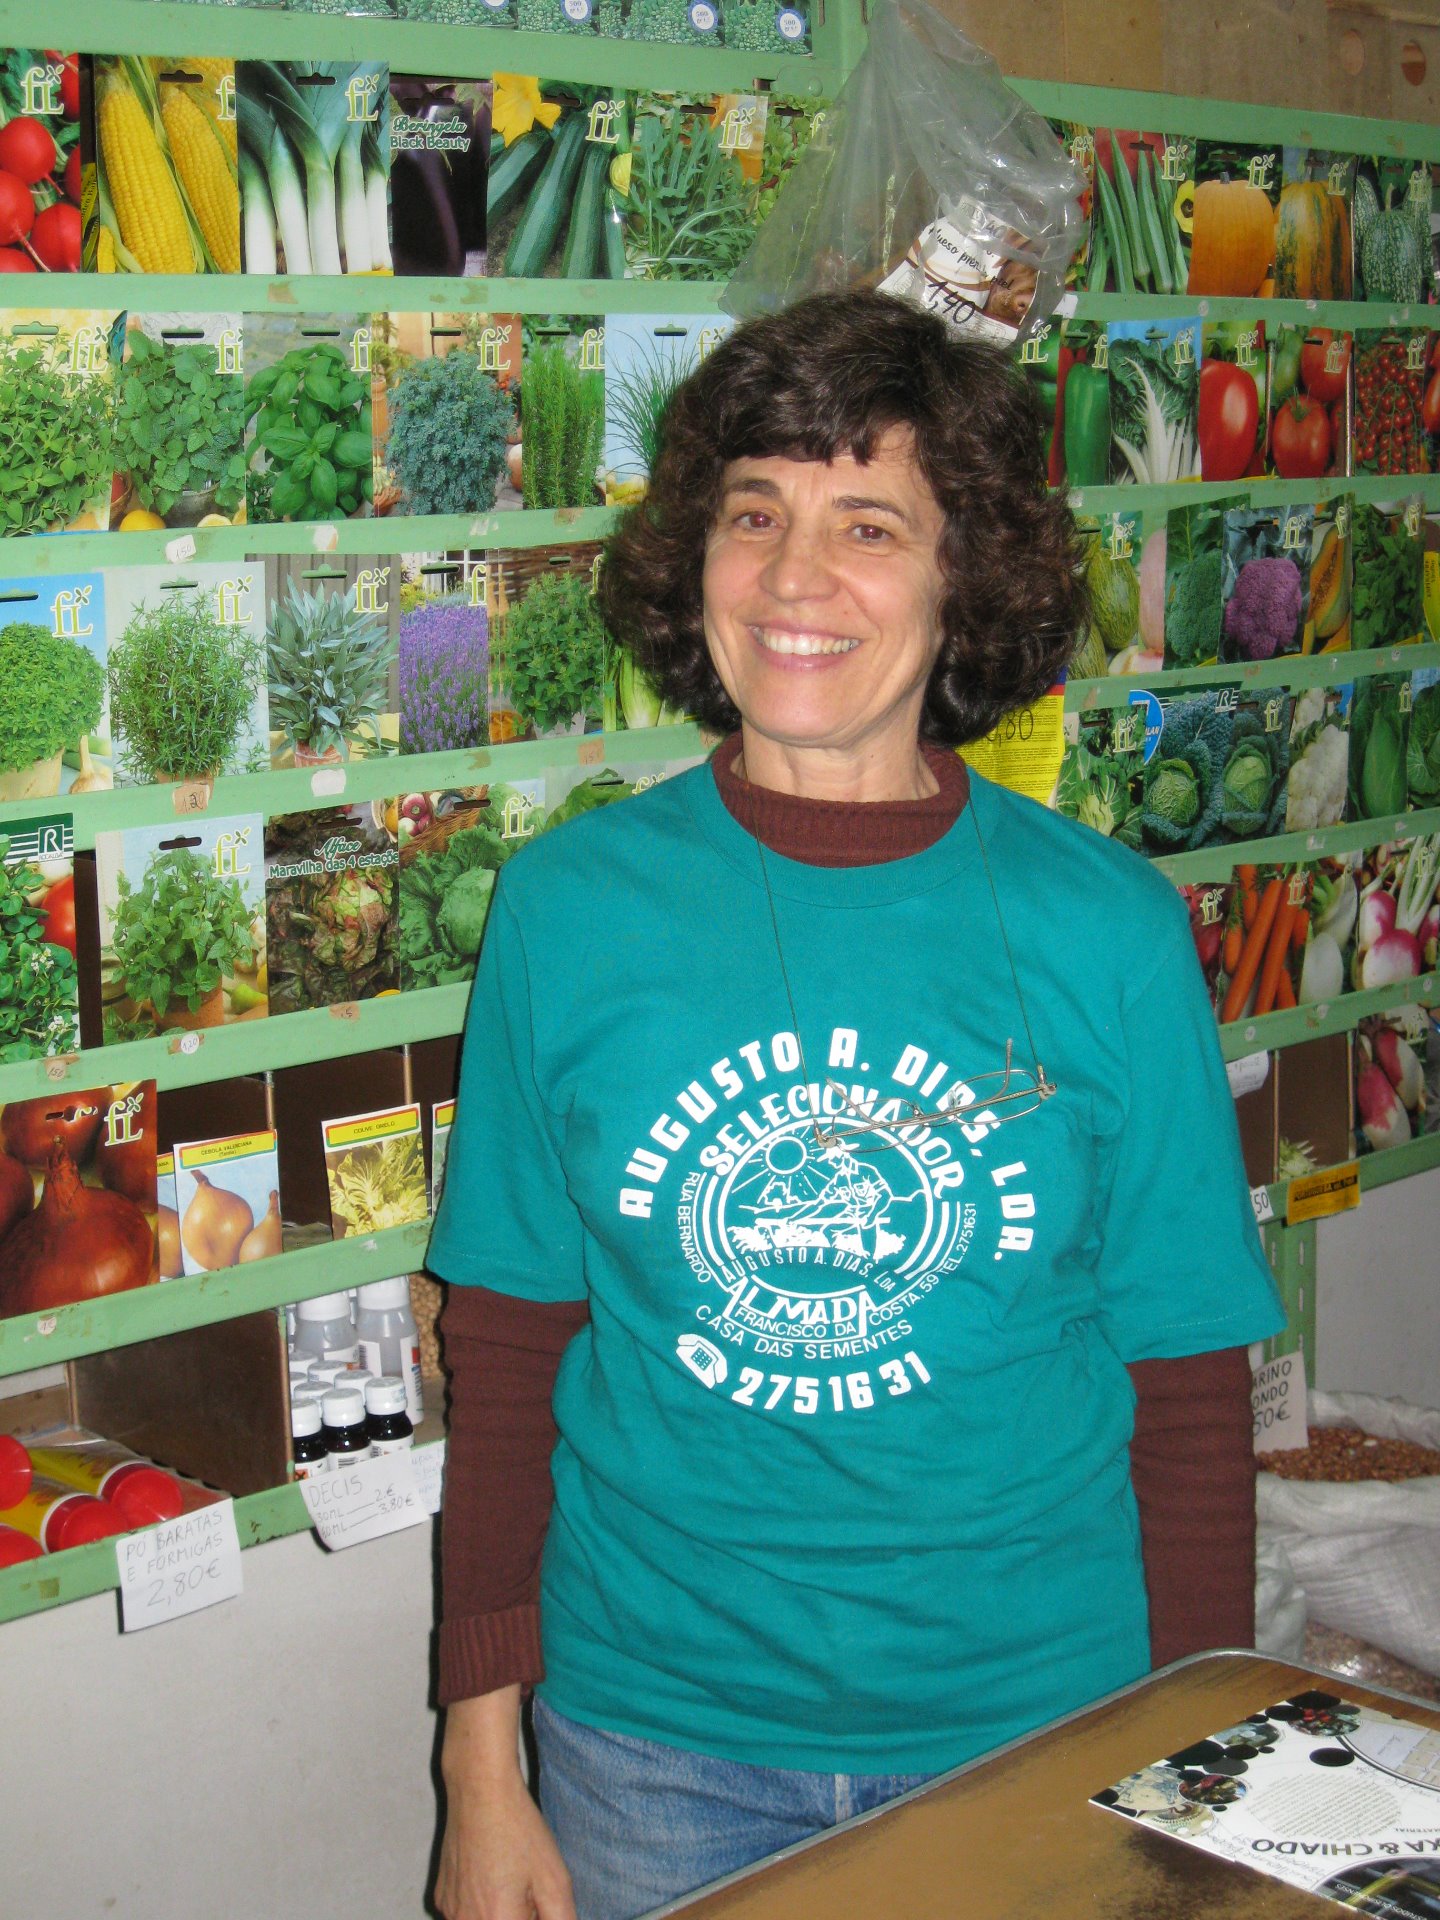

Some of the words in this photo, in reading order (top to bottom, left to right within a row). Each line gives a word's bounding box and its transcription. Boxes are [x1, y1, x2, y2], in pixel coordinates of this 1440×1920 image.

[393, 115, 467, 137] Beringela
[390, 135, 424, 149] Black
[426, 135, 470, 152] Beauty
[927, 281, 976, 324] 1,40
[269, 860, 323, 878] Maravilha
[325, 858, 346, 872] das
[347, 855, 356, 868] 4
[358, 849, 399, 867] estaçõe
[314, 836, 361, 859] Alface
[619, 1031, 799, 1218] AUGUSTO
[829, 1027, 870, 1071] A.
[991, 1161, 1036, 1261] LDA.
[700, 1082, 965, 1198] SELECIONADOR
[679, 1171, 701, 1202] RUA
[677, 1206, 712, 1283] BERNARDO
[721, 1247, 807, 1283] AUGUSTO
[919, 1274, 940, 1293] 59
[722, 1276, 877, 1337] ALMADA
[735, 1305, 827, 1338] FRANCISCO
[696, 1305, 745, 1346] CASA
[754, 1338, 794, 1358] DAS
[804, 1319, 913, 1359] SEMENTES
[835, 1322, 856, 1337] DA
[308, 1474, 362, 1507] DECIS
[127, 1535, 146, 1562] PÓ
[156, 1510, 222, 1550] BARATAS
[127, 1566, 136, 1582] E
[147, 1532, 223, 1574] FORMIGAS
[1251, 1838, 1373, 1856] CHIADO
